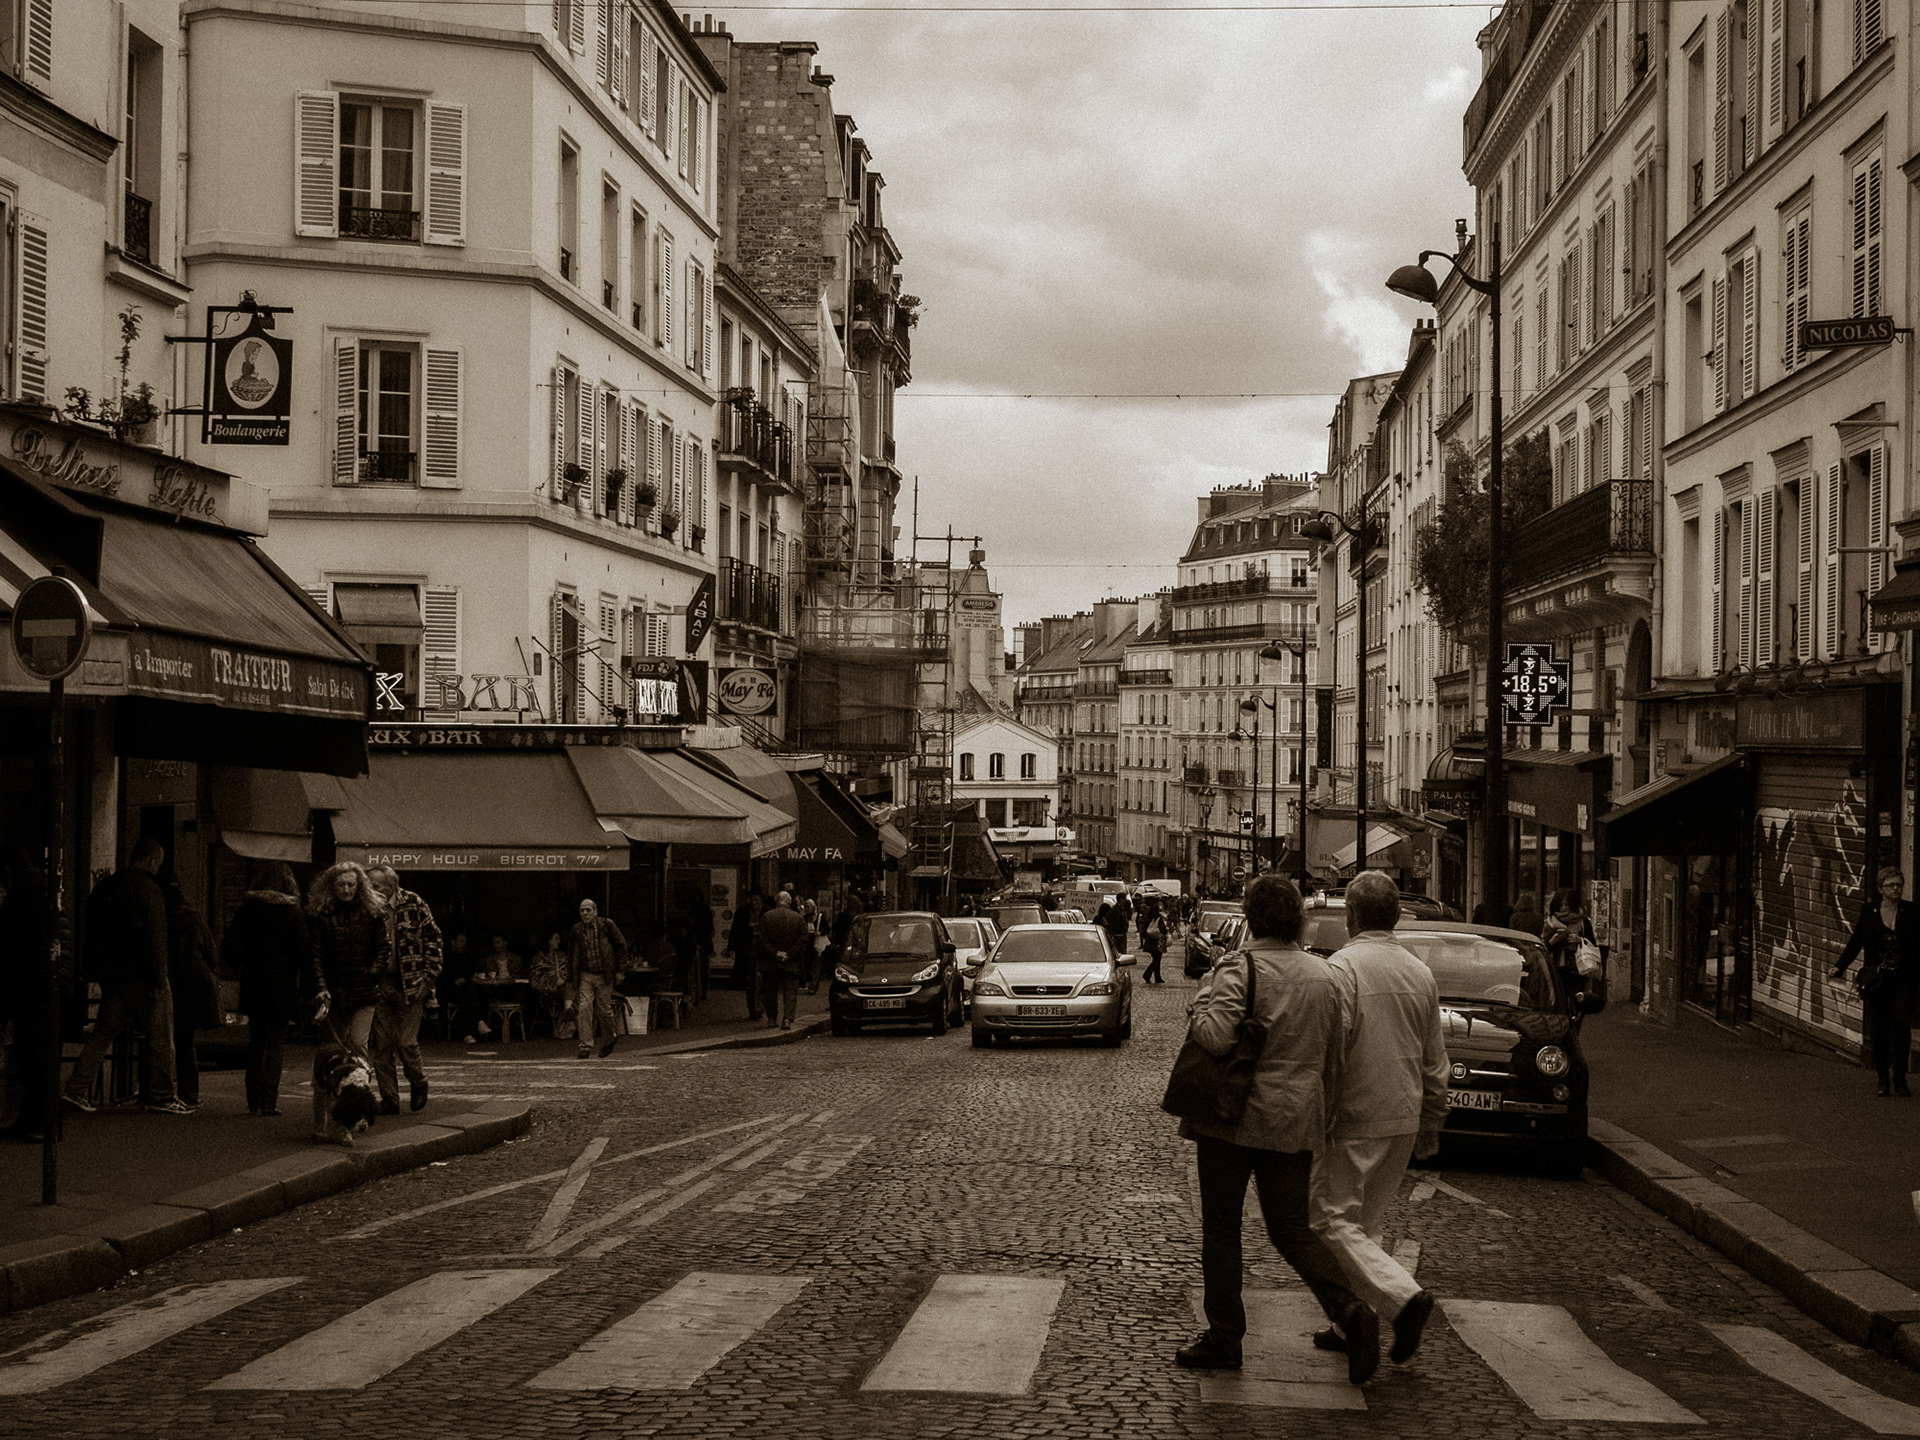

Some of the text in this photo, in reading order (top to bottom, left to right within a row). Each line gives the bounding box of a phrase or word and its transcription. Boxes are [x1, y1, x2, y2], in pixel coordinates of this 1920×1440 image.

[1809, 323, 1888, 343] NICOLAS
[214, 424, 287, 440] Boulangerie
[690, 591, 711, 638] TABAC
[211, 648, 293, 693] TRAITEUR
[637, 663, 655, 672] FDJ
[433, 674, 541, 712] BAR
[721, 681, 775, 704] May Fa
[368, 730, 483, 744] UX BAR
[1433, 791, 1479, 800] PALACE
[368, 855, 600, 865] HAPPY HOUR BISTROT 7/7
[787, 848, 818, 859] MAY
[825, 848, 843, 859] FA
